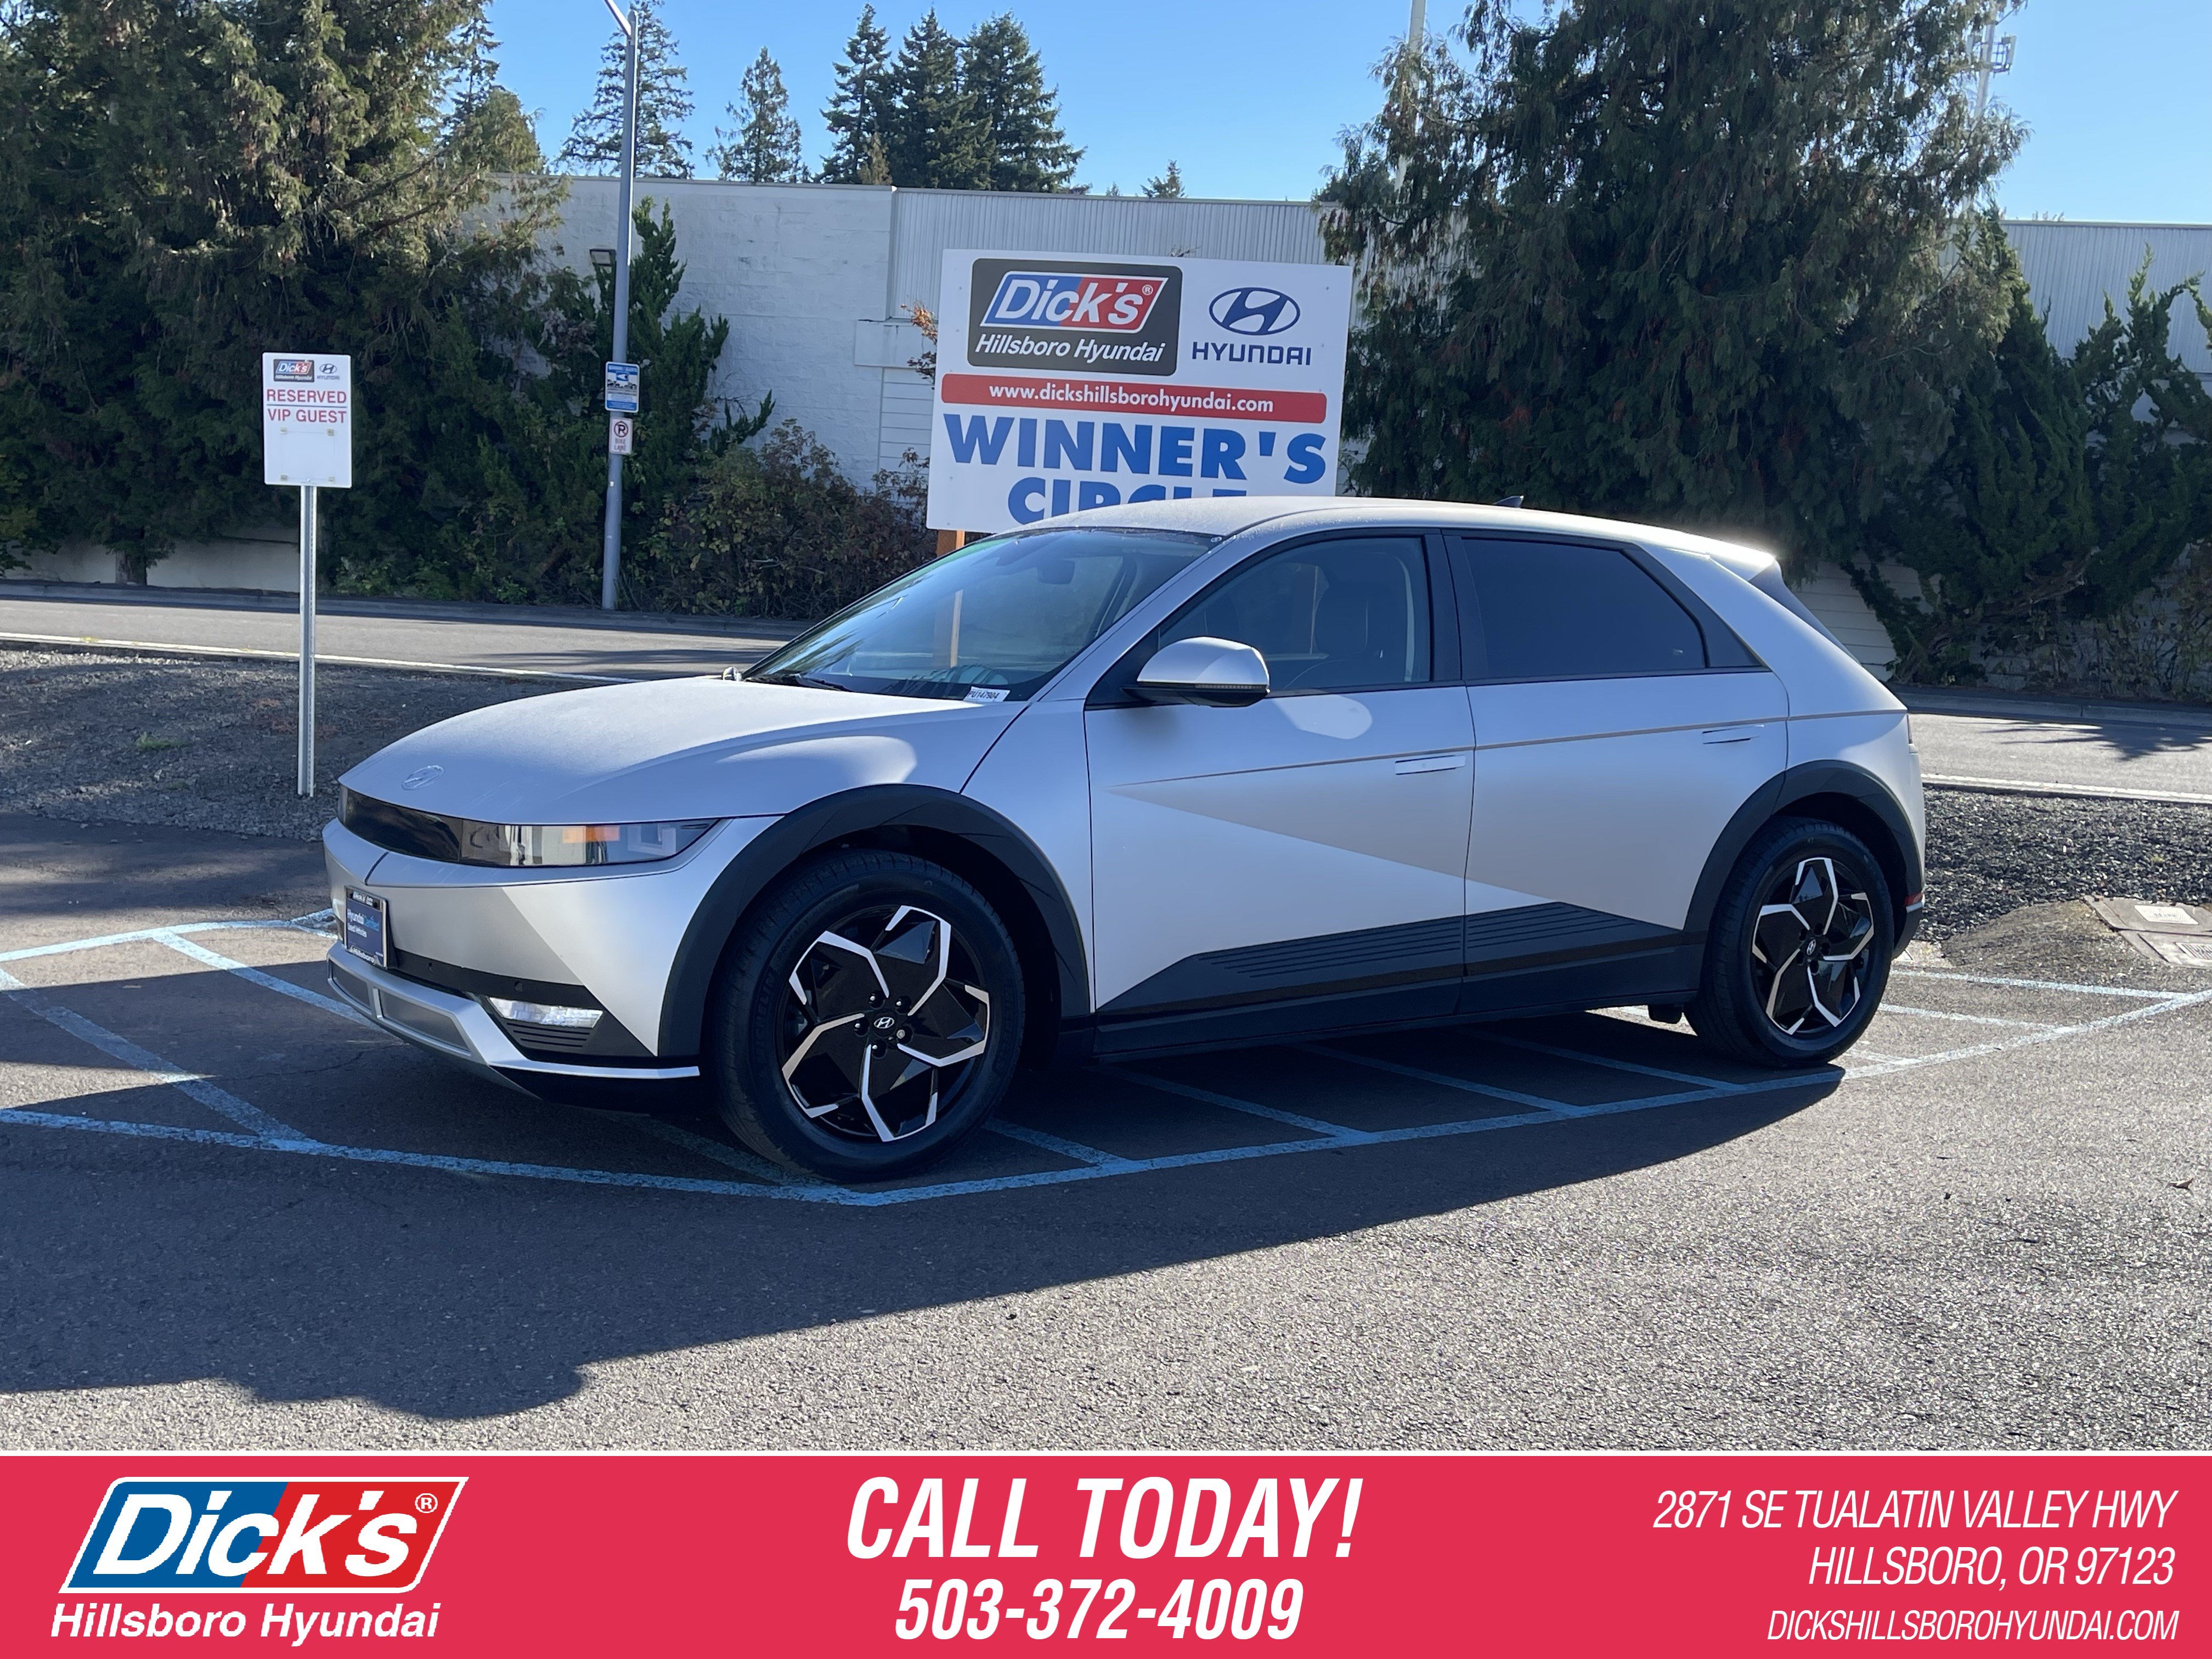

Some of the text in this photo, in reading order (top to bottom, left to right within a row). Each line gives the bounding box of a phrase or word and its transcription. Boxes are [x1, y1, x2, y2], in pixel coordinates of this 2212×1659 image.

[975, 334, 1166, 366] Hillsboro Hyundai
[1193, 341, 1312, 366] HYUNDAI
[267, 389, 347, 404] RESERVED
[989, 383, 1273, 413] www.dickshillsborohyundai.com
[268, 409, 347, 423] VIP GUEST
[943, 414, 1327, 484] WINNER'S
[1008, 477, 1246, 524] CIR
